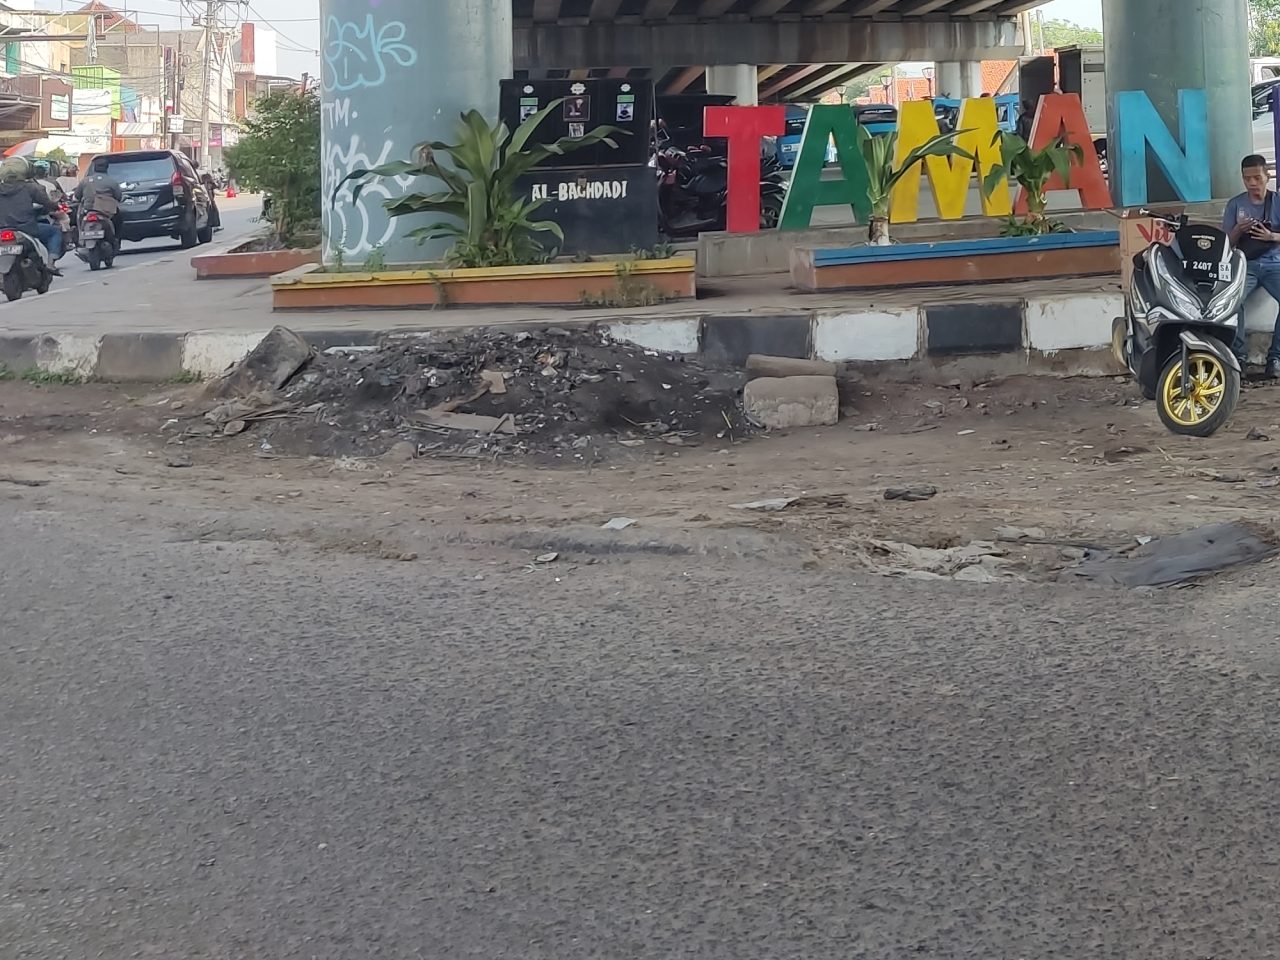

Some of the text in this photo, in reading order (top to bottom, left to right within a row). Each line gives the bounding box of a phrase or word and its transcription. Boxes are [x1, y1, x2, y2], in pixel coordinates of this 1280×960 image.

[703, 89, 1211, 233] TAMAN
[1182, 260, 1188, 269] T
[1192, 261, 1212, 272] 2407
